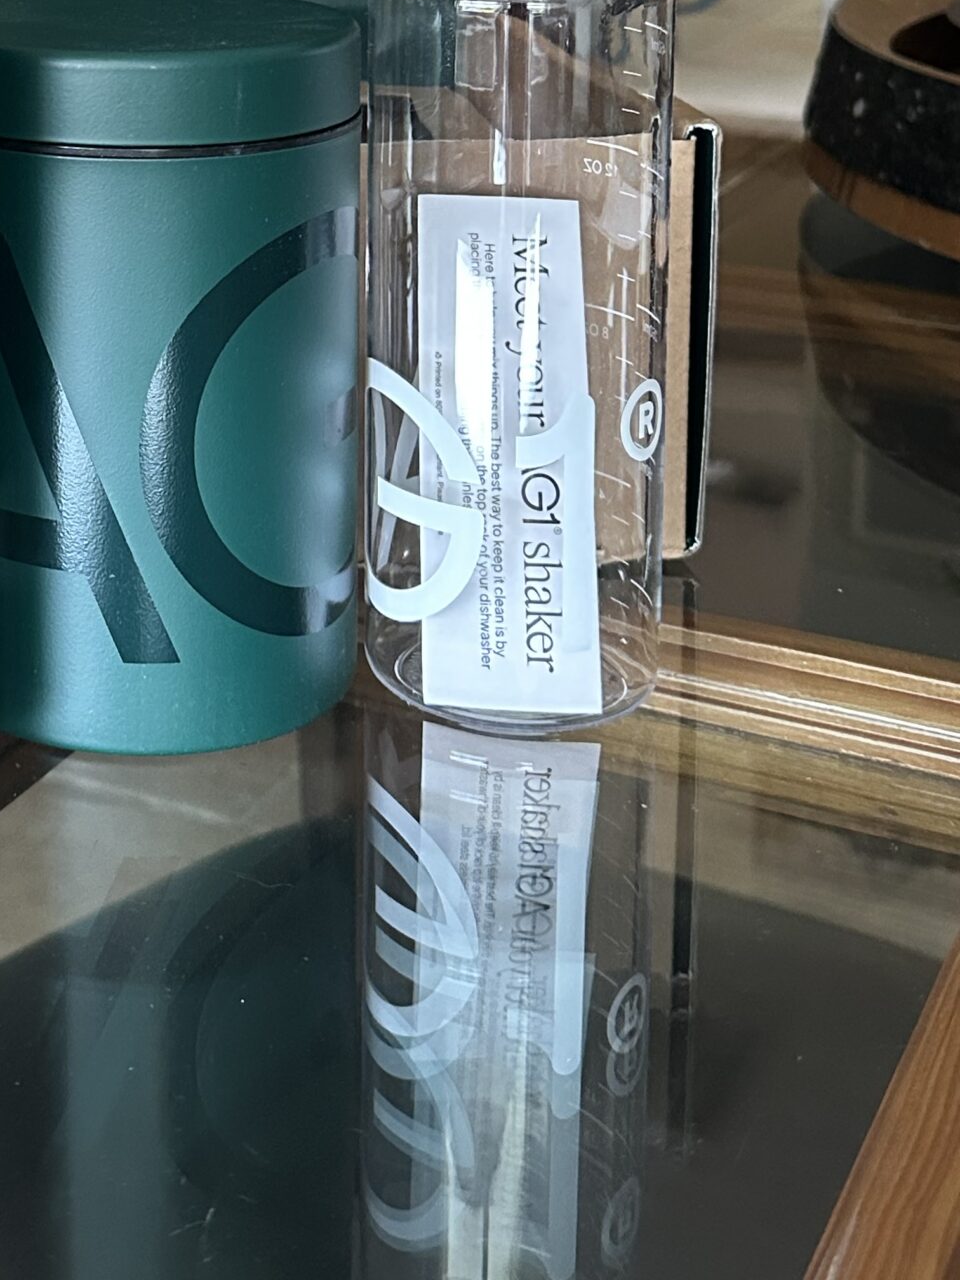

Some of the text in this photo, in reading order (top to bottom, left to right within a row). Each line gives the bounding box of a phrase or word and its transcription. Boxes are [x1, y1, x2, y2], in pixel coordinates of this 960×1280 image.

[484, 243, 495, 273] Here
[490, 436, 502, 461] The
[490, 463, 502, 492] best
[475, 489, 488, 510] top
[488, 495, 501, 521] way
[492, 524, 503, 538] to
[489, 540, 505, 572] keep
[477, 561, 490, 590] your
[494, 576, 506, 584] it
[494, 587, 507, 623] clean
[522, 540, 563, 673] shaker
[478, 593, 493, 670] dishwasher
[495, 626, 507, 637] is
[492, 640, 508, 658] by
